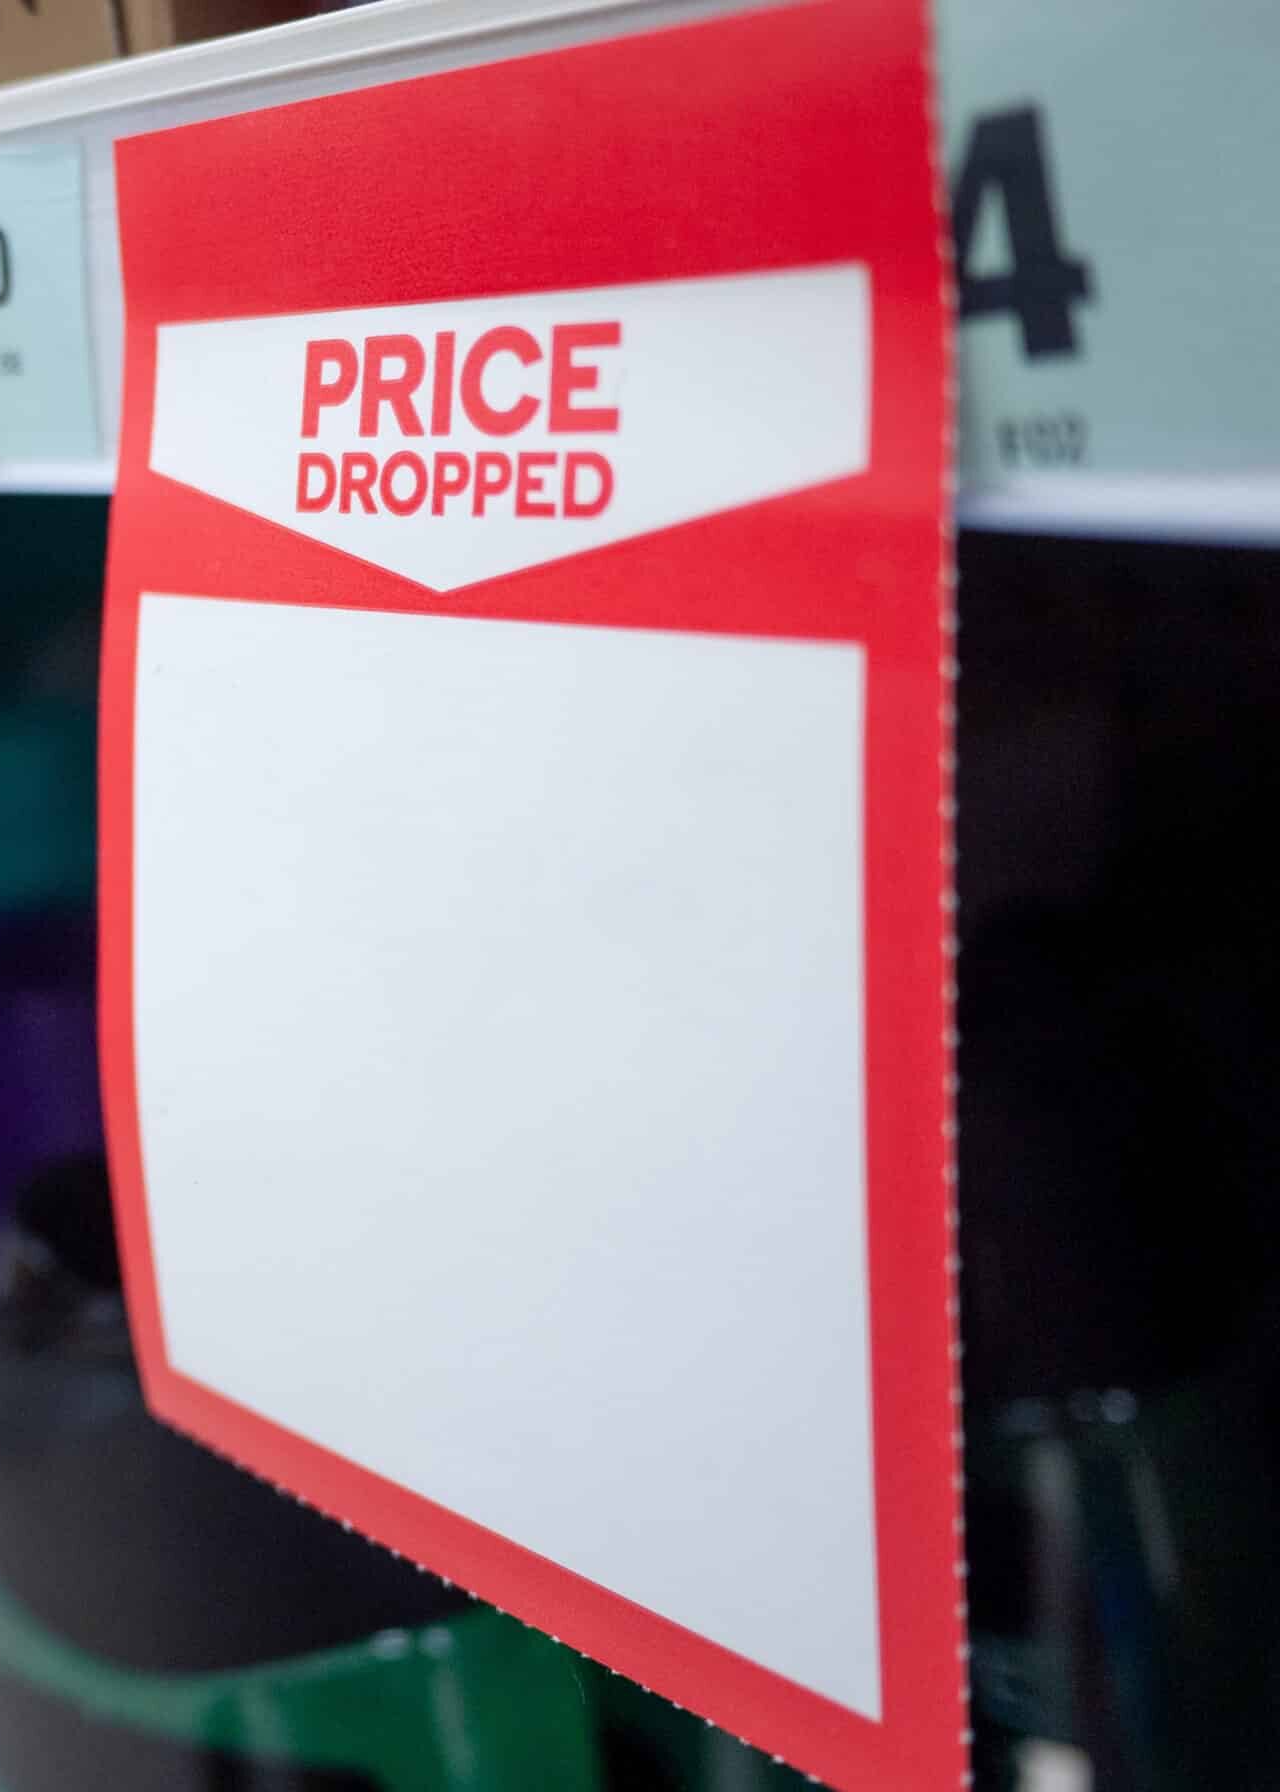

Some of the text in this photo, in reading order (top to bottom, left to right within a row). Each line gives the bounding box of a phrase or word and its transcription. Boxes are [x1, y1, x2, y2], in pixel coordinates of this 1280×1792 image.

[953, 100, 1094, 362] 4
[301, 321, 622, 438] PRICE
[295, 450, 614, 519] DROPPED
